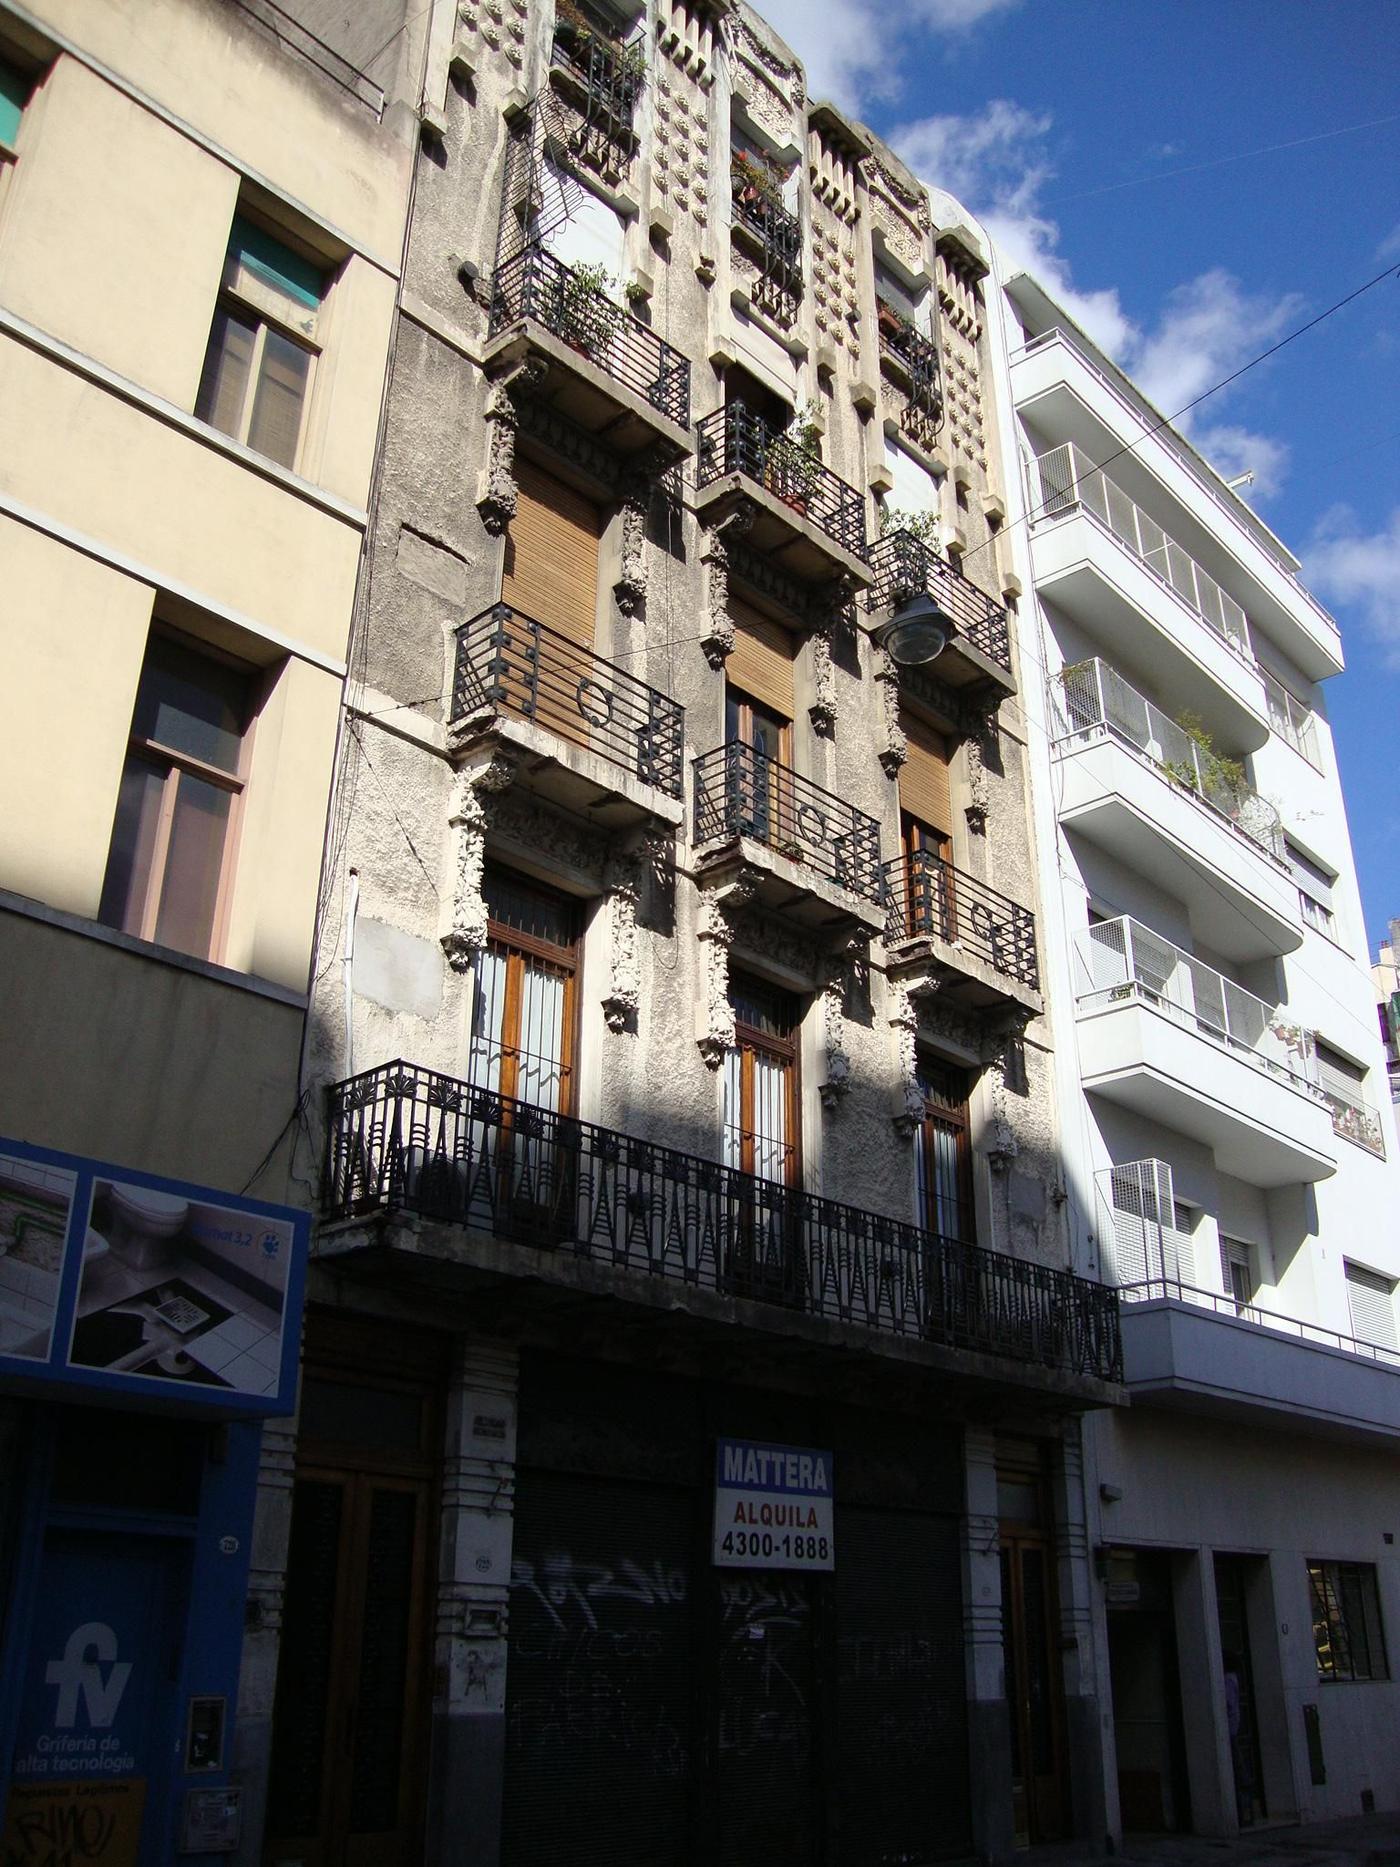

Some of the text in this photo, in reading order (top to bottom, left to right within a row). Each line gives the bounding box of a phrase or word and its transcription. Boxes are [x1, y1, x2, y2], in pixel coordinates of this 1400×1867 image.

[723, 1445, 828, 1491] MATTERA
[733, 1501, 819, 1530] ALQUILA
[722, 1531, 829, 1561] 4300-1888
[45, 1621, 135, 1728] fv
[99, 1734, 121, 1751] de
[15, 1753, 48, 1772] alta
